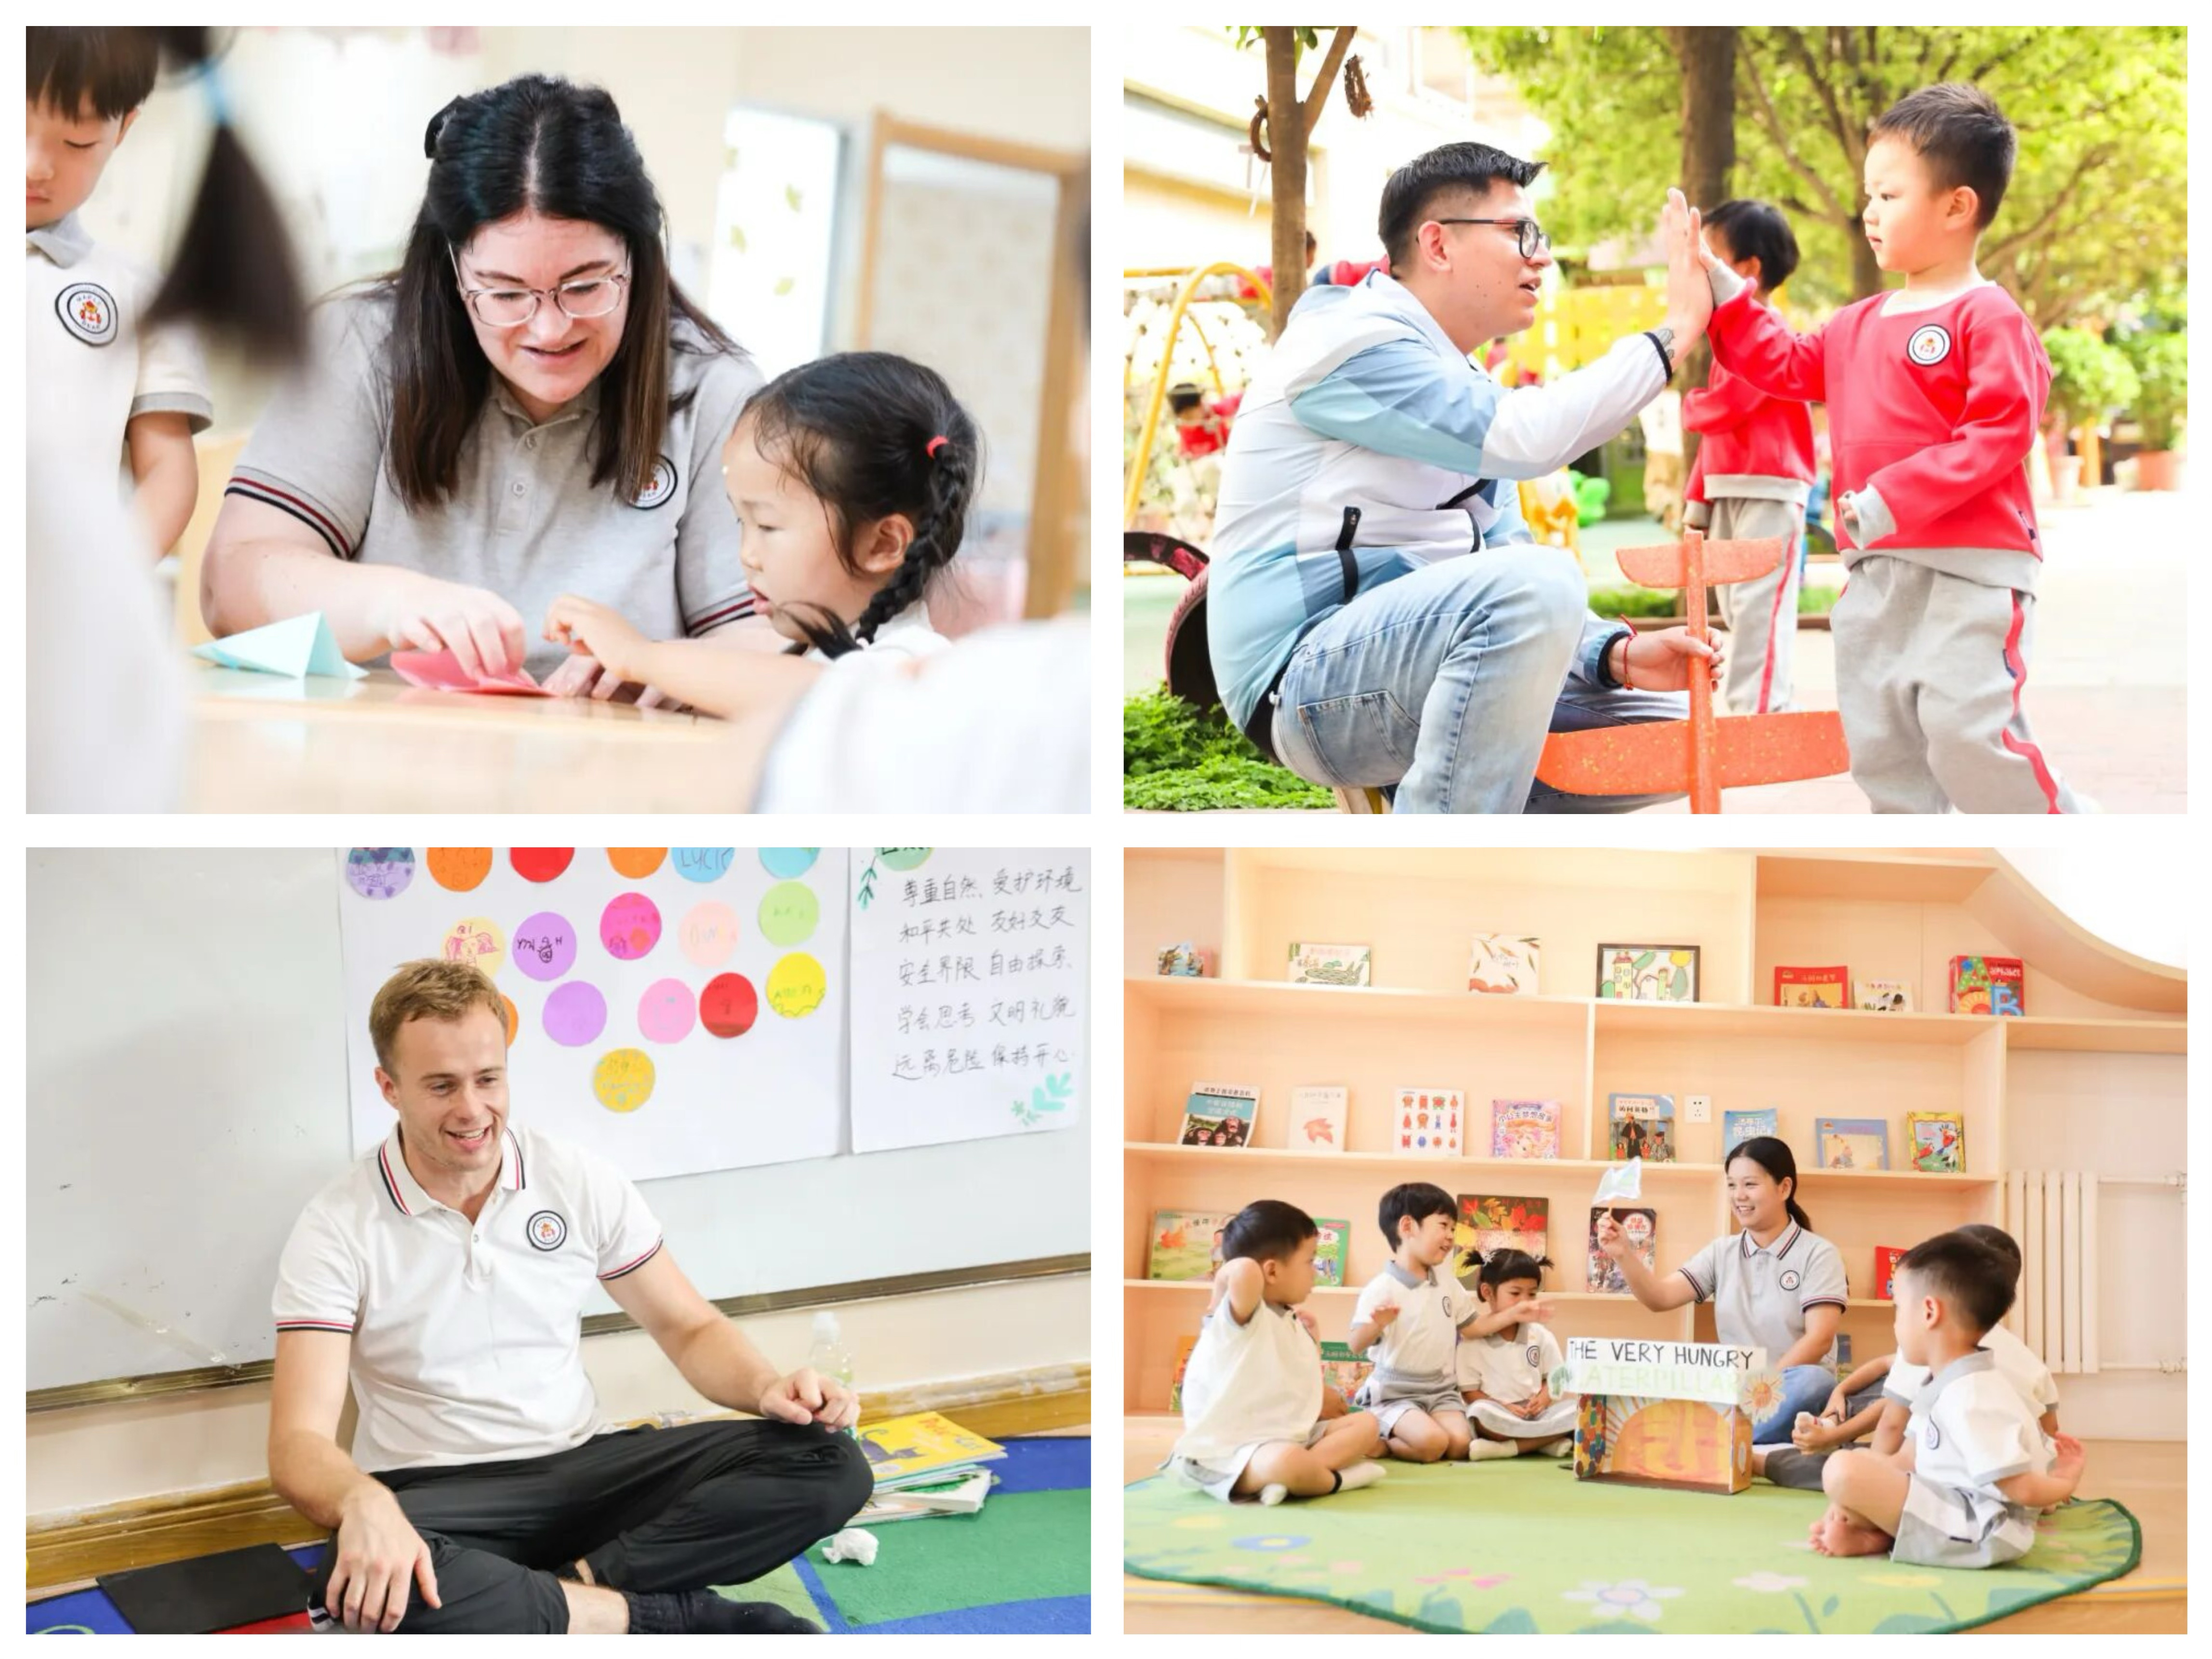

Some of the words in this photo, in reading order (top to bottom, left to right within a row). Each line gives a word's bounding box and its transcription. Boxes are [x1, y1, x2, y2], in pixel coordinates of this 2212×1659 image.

[903, 873, 983, 907] 尊重自然
[899, 916, 976, 944] 和平共处
[898, 954, 981, 987] 安全界限
[989, 945, 1072, 976] 自由探索
[898, 1002, 975, 1034] 学会思考
[988, 993, 1076, 1026] 文明礼貌
[892, 1048, 985, 1080] 远离危险
[1570, 1340, 1597, 1360] THE
[1611, 1341, 1665, 1363] VERY
[1675, 1346, 1754, 1370] HUNGRY
